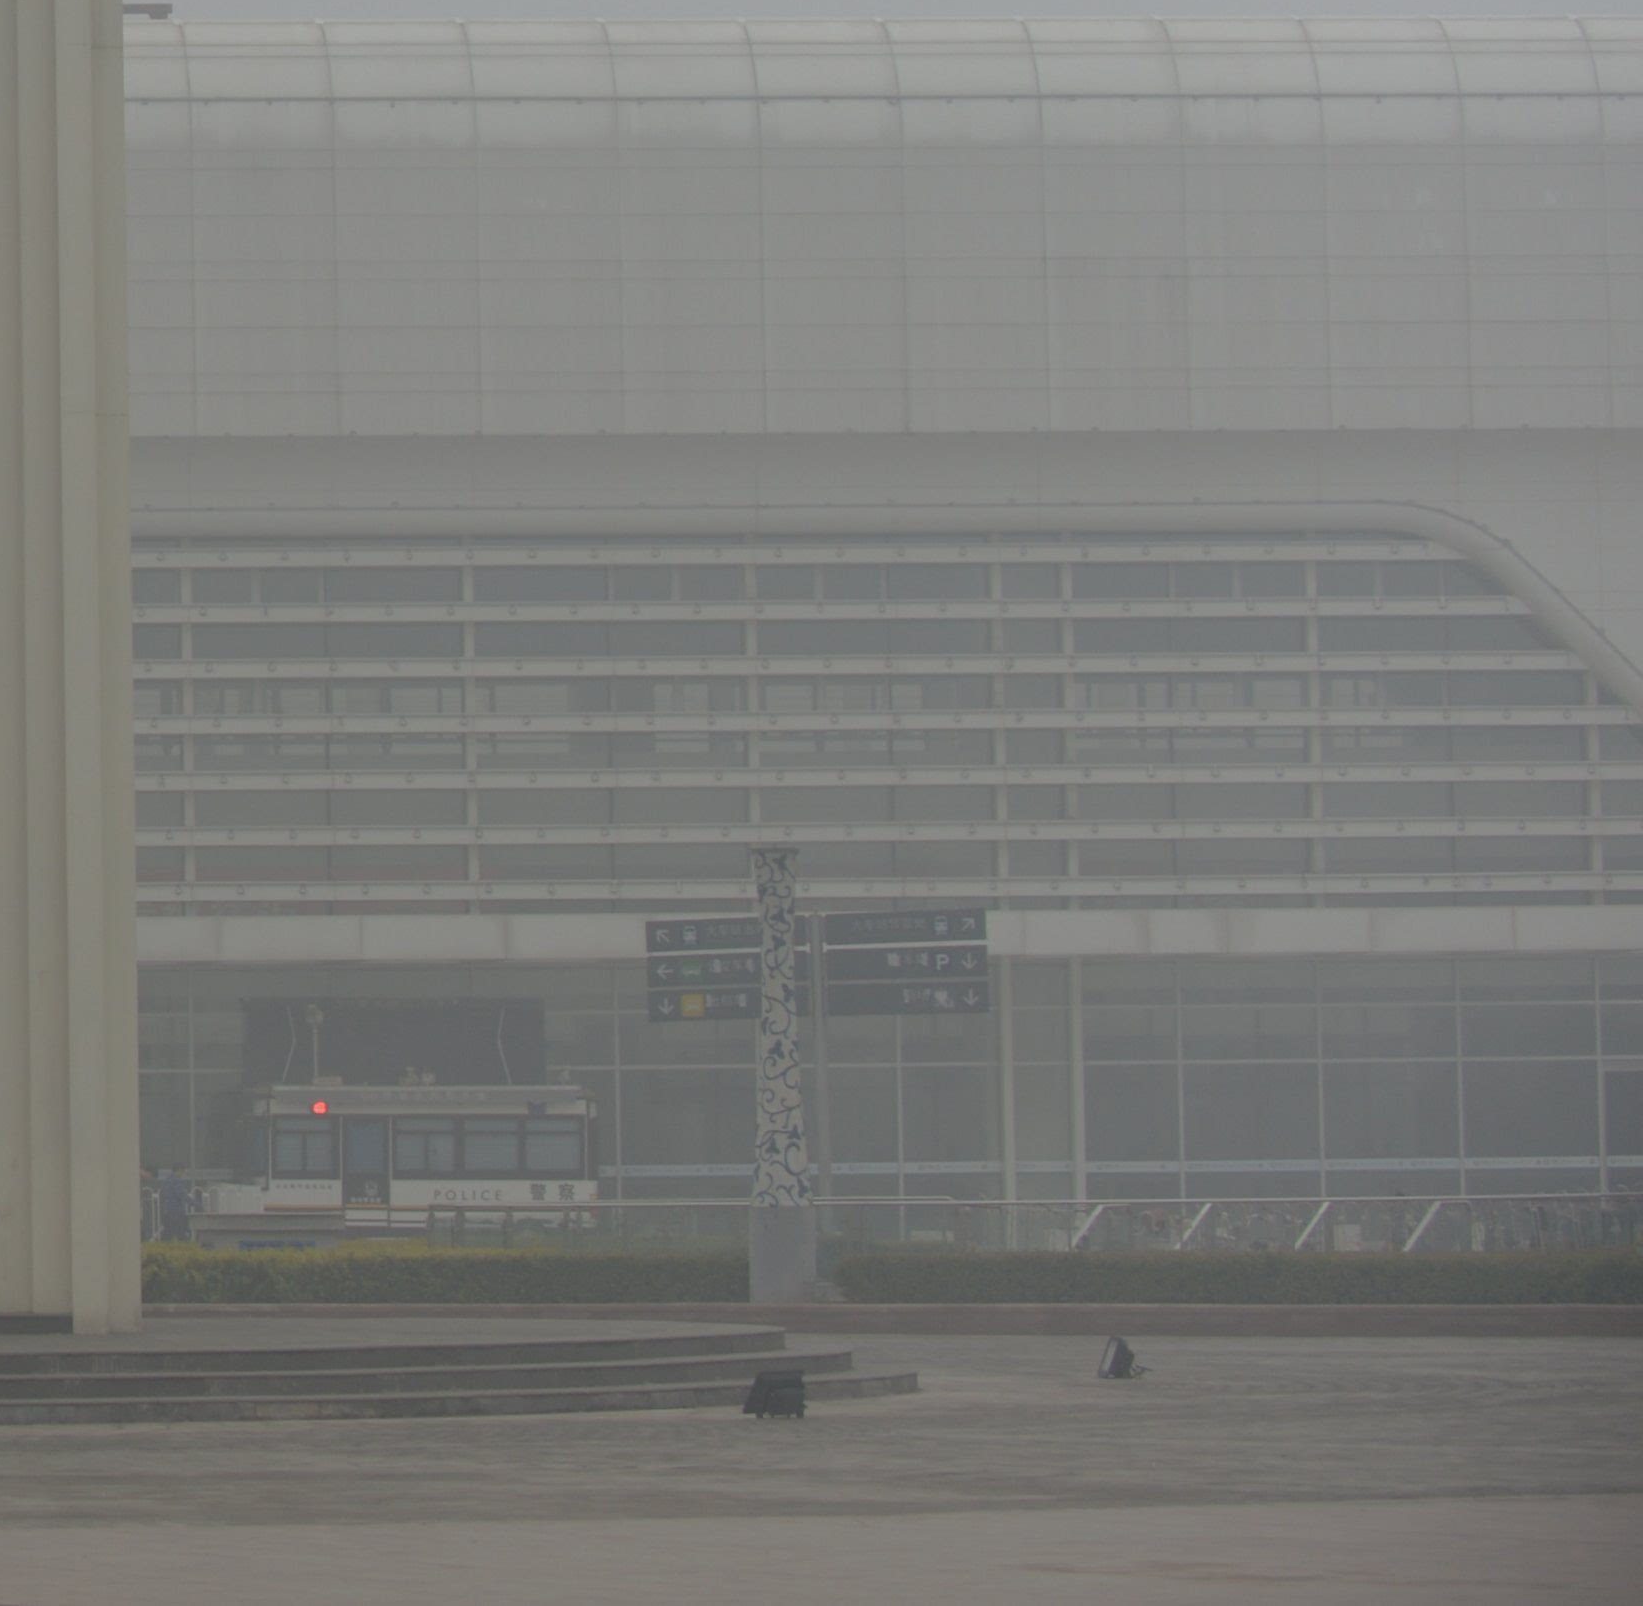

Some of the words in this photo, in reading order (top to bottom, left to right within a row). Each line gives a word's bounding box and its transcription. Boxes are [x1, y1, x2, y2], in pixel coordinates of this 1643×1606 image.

[935, 953, 950, 971] P
[433, 1189, 503, 1201] POLICE
[530, 1183, 575, 1201] 警察
